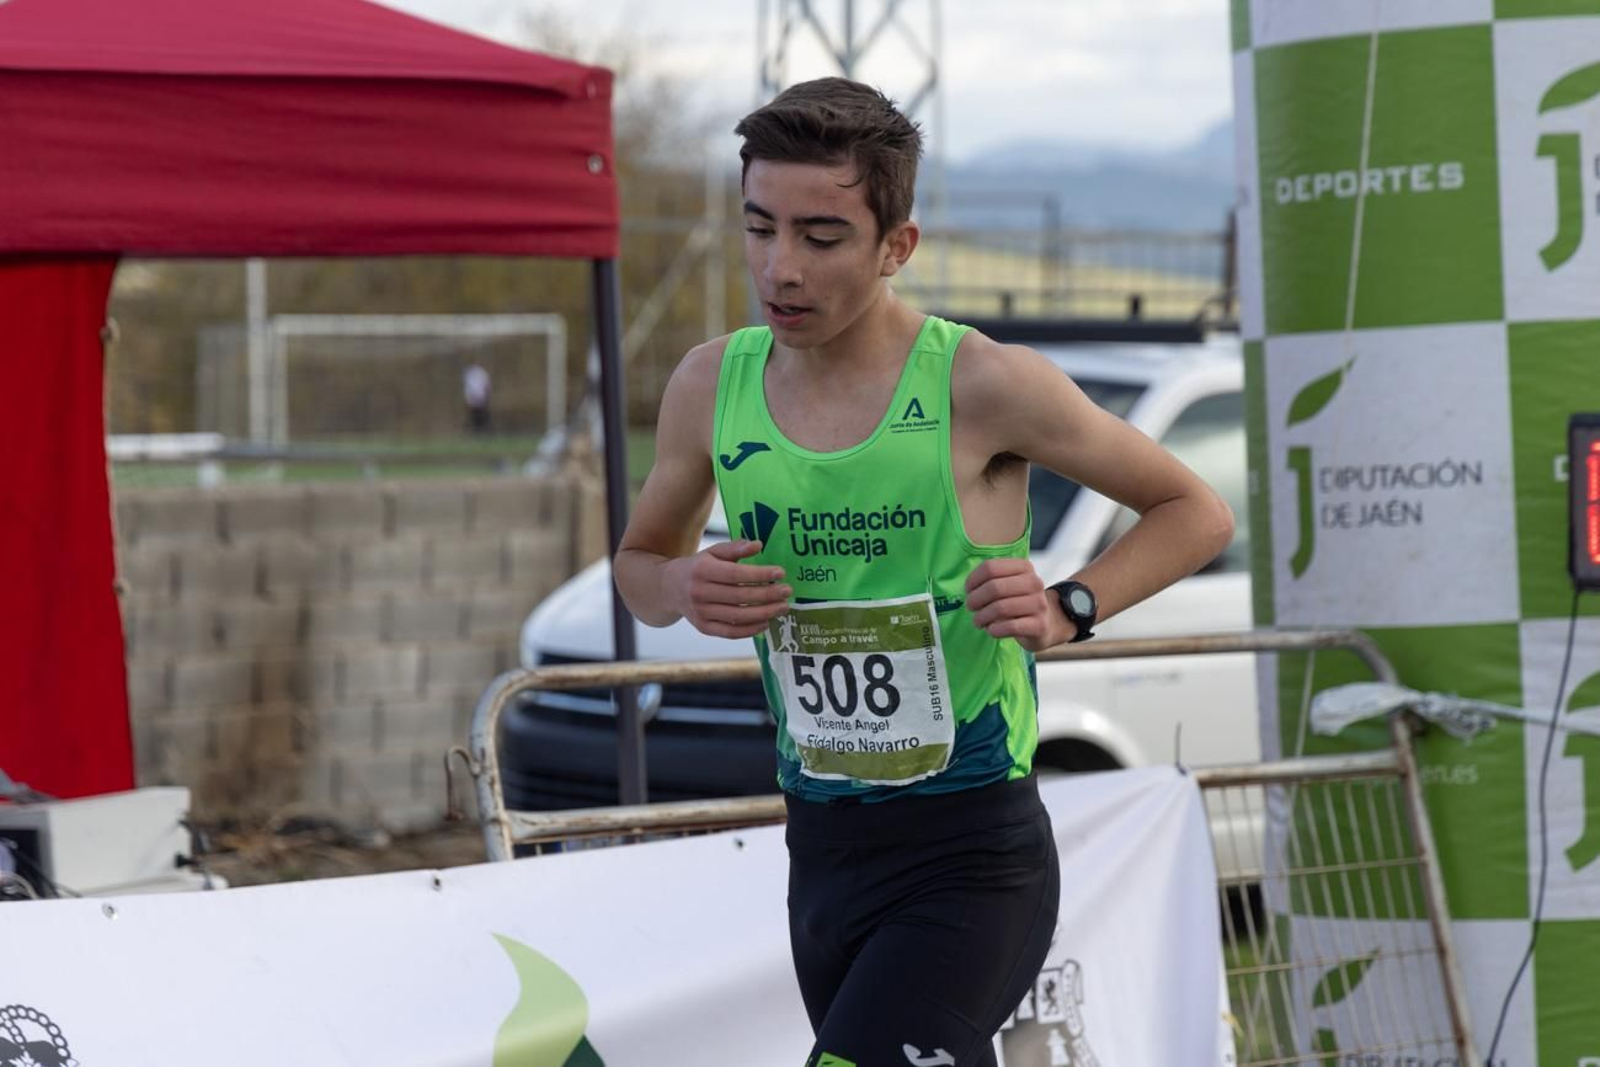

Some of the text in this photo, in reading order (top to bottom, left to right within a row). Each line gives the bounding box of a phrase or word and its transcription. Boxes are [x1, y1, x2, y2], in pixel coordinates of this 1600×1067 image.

[1275, 161, 1464, 204] DEPORTES
[1319, 457, 1483, 493] DIPUTACIÓN
[787, 503, 926, 532] Fundación
[1320, 495, 1423, 529] DE JAÉN
[790, 532, 888, 563] Unicaja
[796, 565, 837, 582] Jaén
[801, 633, 879, 646] Campo a través
[791, 653, 901, 718] 508
[921, 626, 944, 721] SUB16 Masculino
[814, 716, 890, 734] Vicente Angel
[807, 733, 920, 755] Fidalgo Navarro
